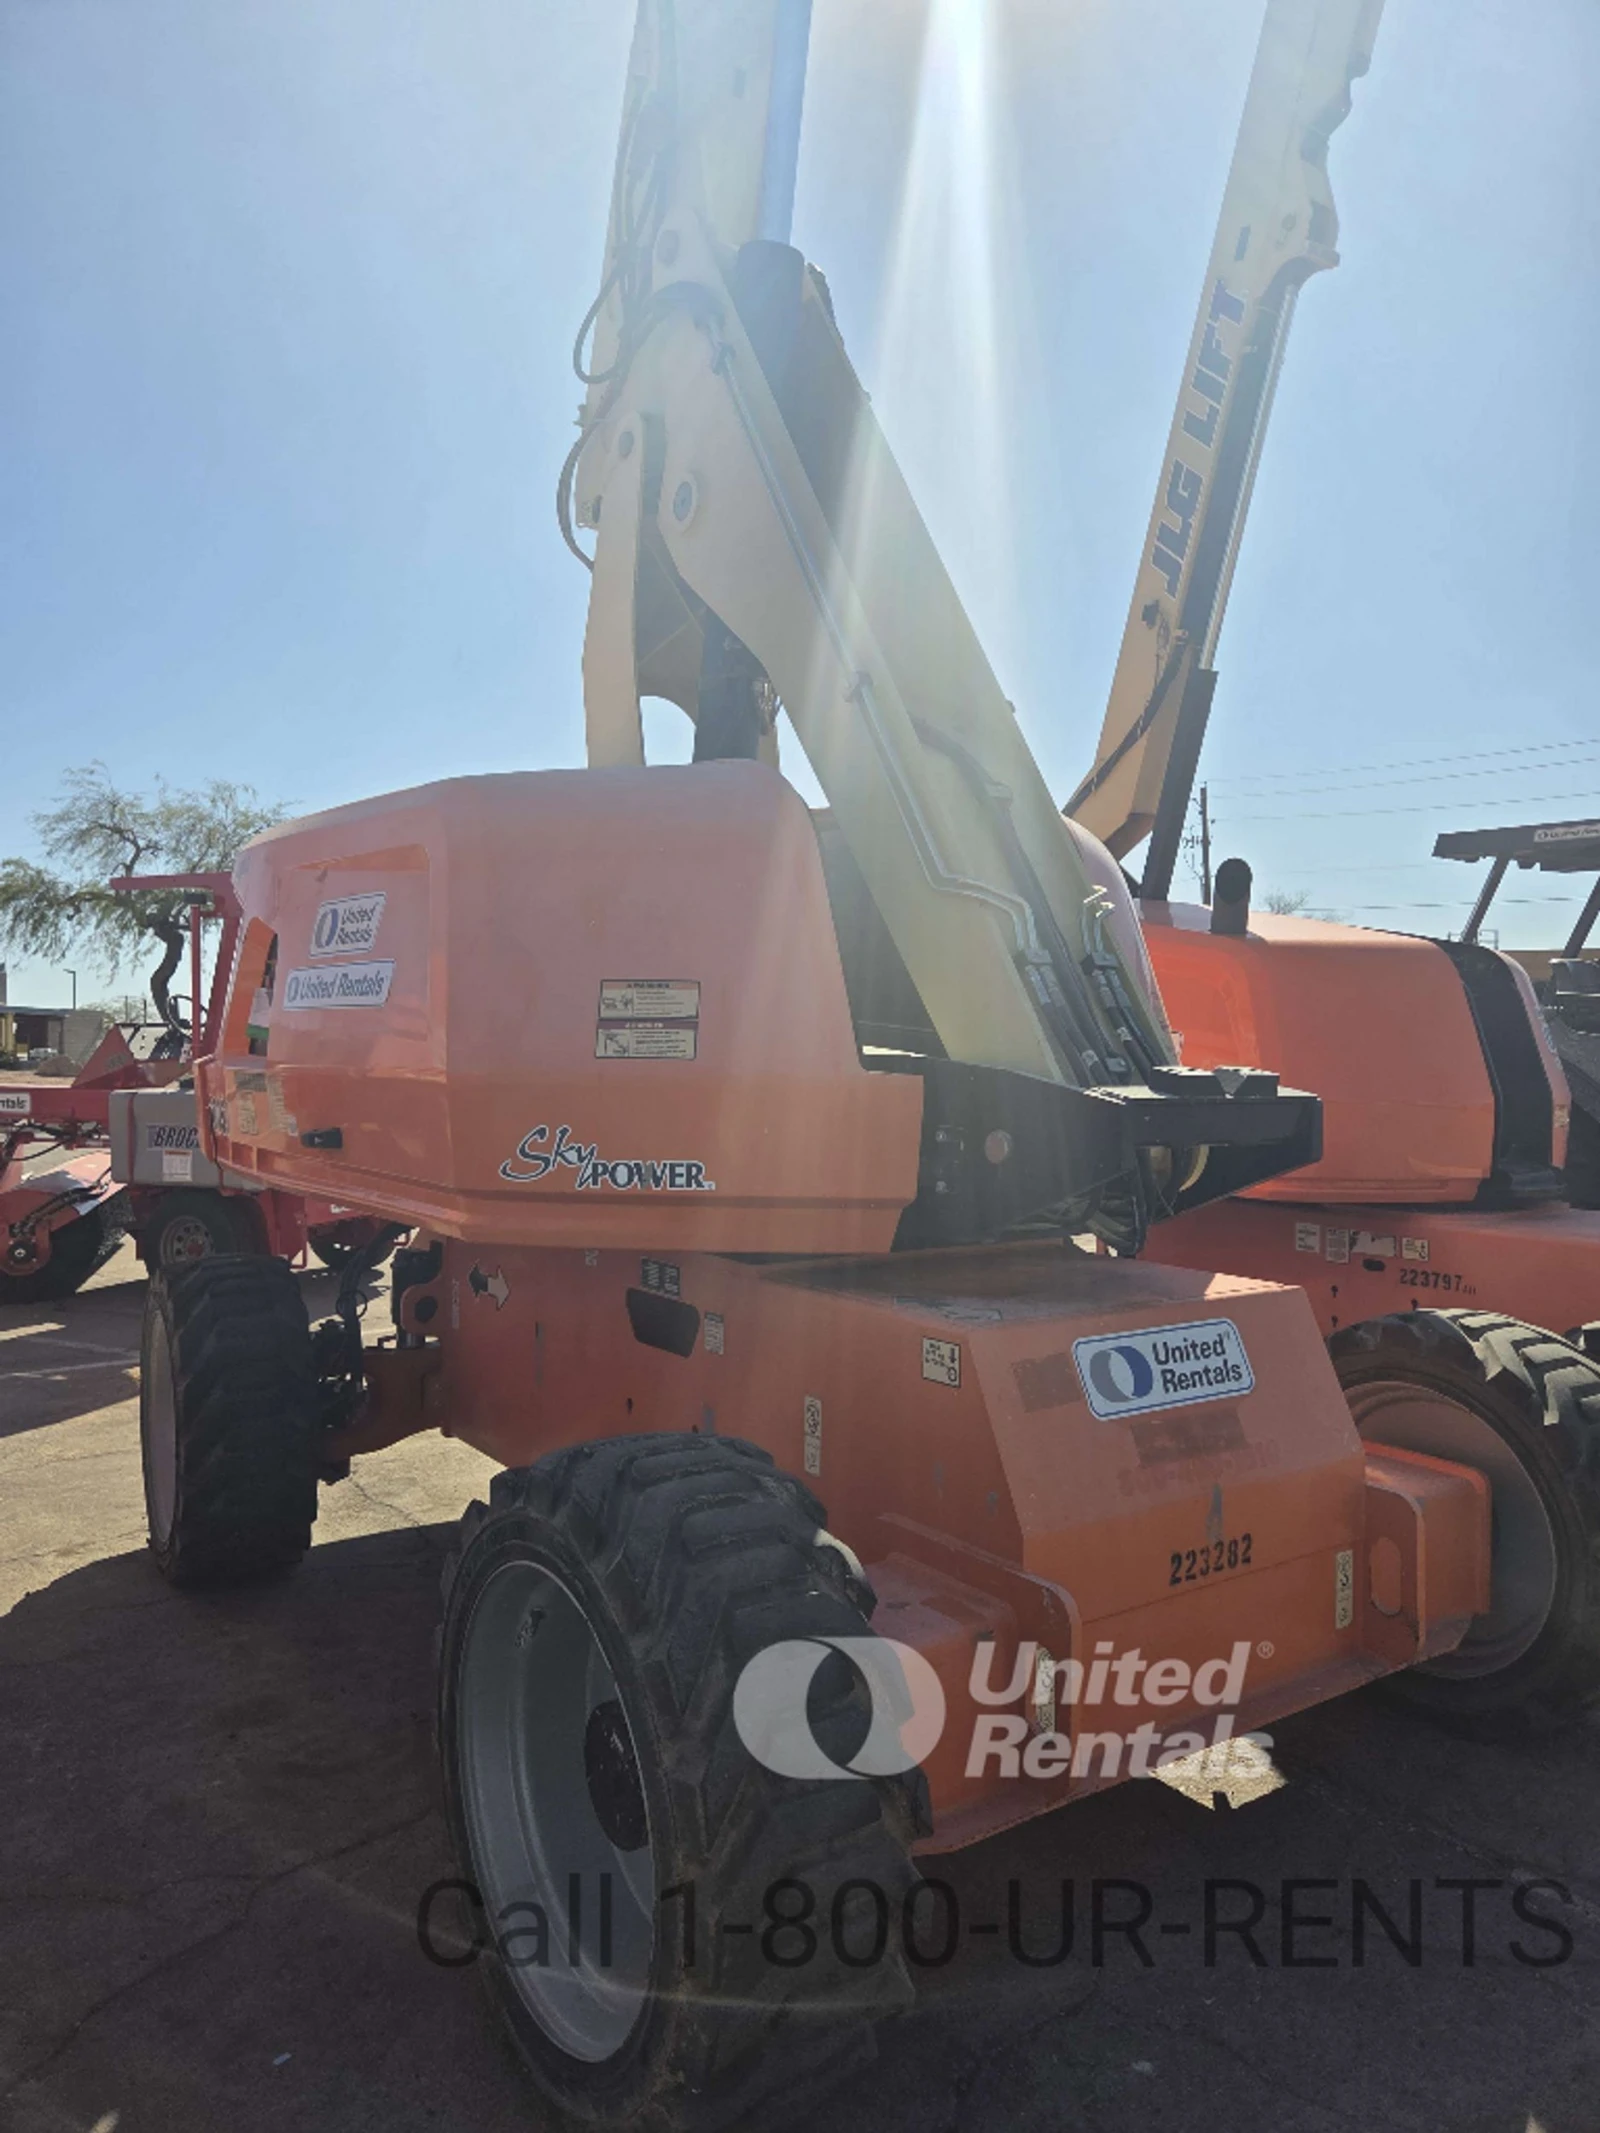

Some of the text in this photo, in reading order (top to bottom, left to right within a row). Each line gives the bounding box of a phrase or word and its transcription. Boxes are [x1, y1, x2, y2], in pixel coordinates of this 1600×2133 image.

[1151, 278, 1245, 600] JLG LIFT
[300, 970, 386, 999] United Rentals
[154, 1125, 200, 1148] BROC
[499, 1124, 598, 1189] Sky
[588, 1160, 706, 1190] POWER
[1400, 1268, 1462, 1292] 223797
[1152, 1333, 1226, 1366] United
[1160, 1359, 1243, 1394] Rentals
[1169, 1533, 1252, 1586] 223282
